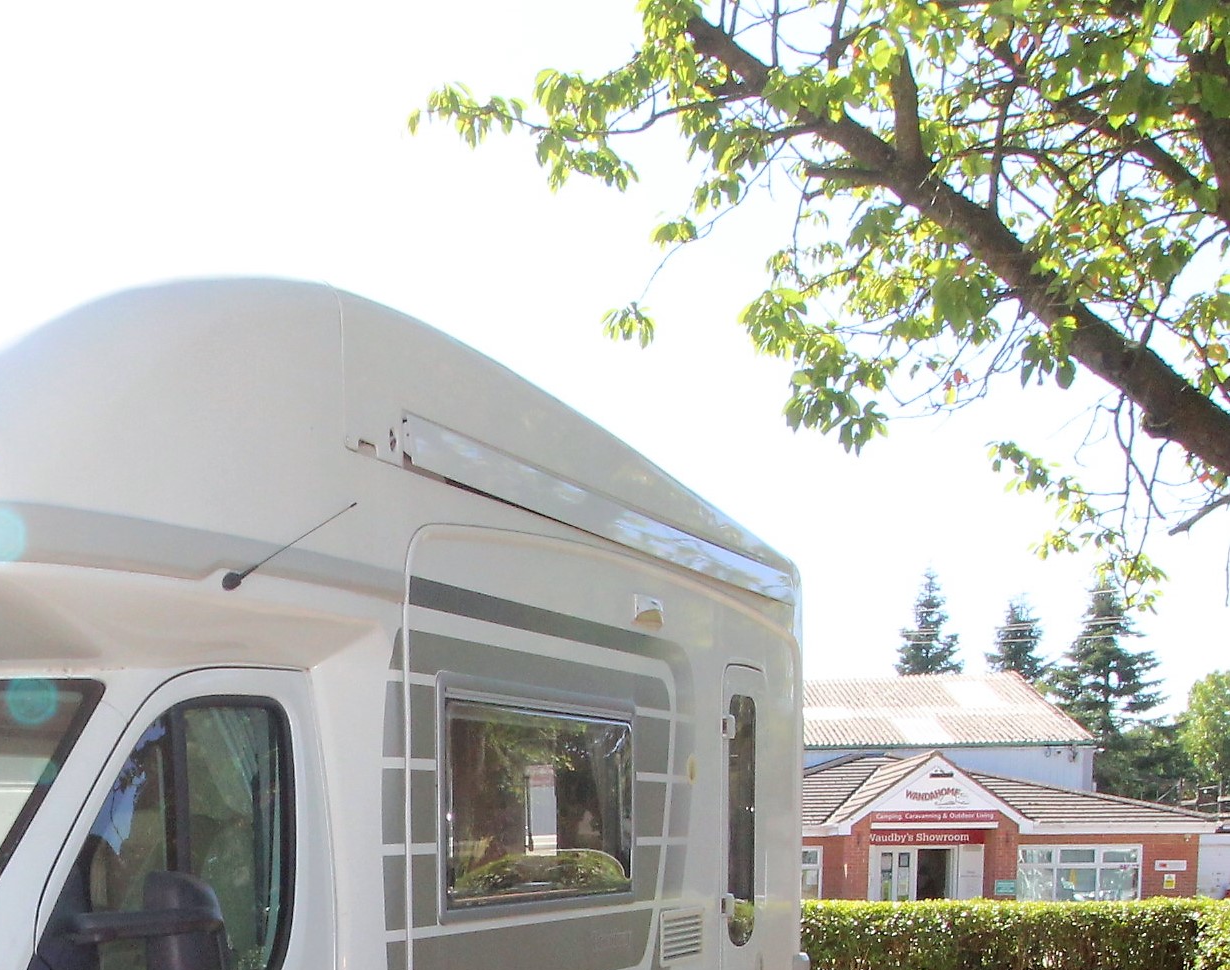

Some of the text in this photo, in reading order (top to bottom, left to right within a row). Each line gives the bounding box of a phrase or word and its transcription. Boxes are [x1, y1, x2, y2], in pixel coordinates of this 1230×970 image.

[905, 787, 962, 802] WANDAHOME
[905, 812, 942, 821] Caravanning
[949, 812, 975, 820] Outdoor
[976, 812, 994, 821] Living
[916, 832, 970, 842] Showroom
